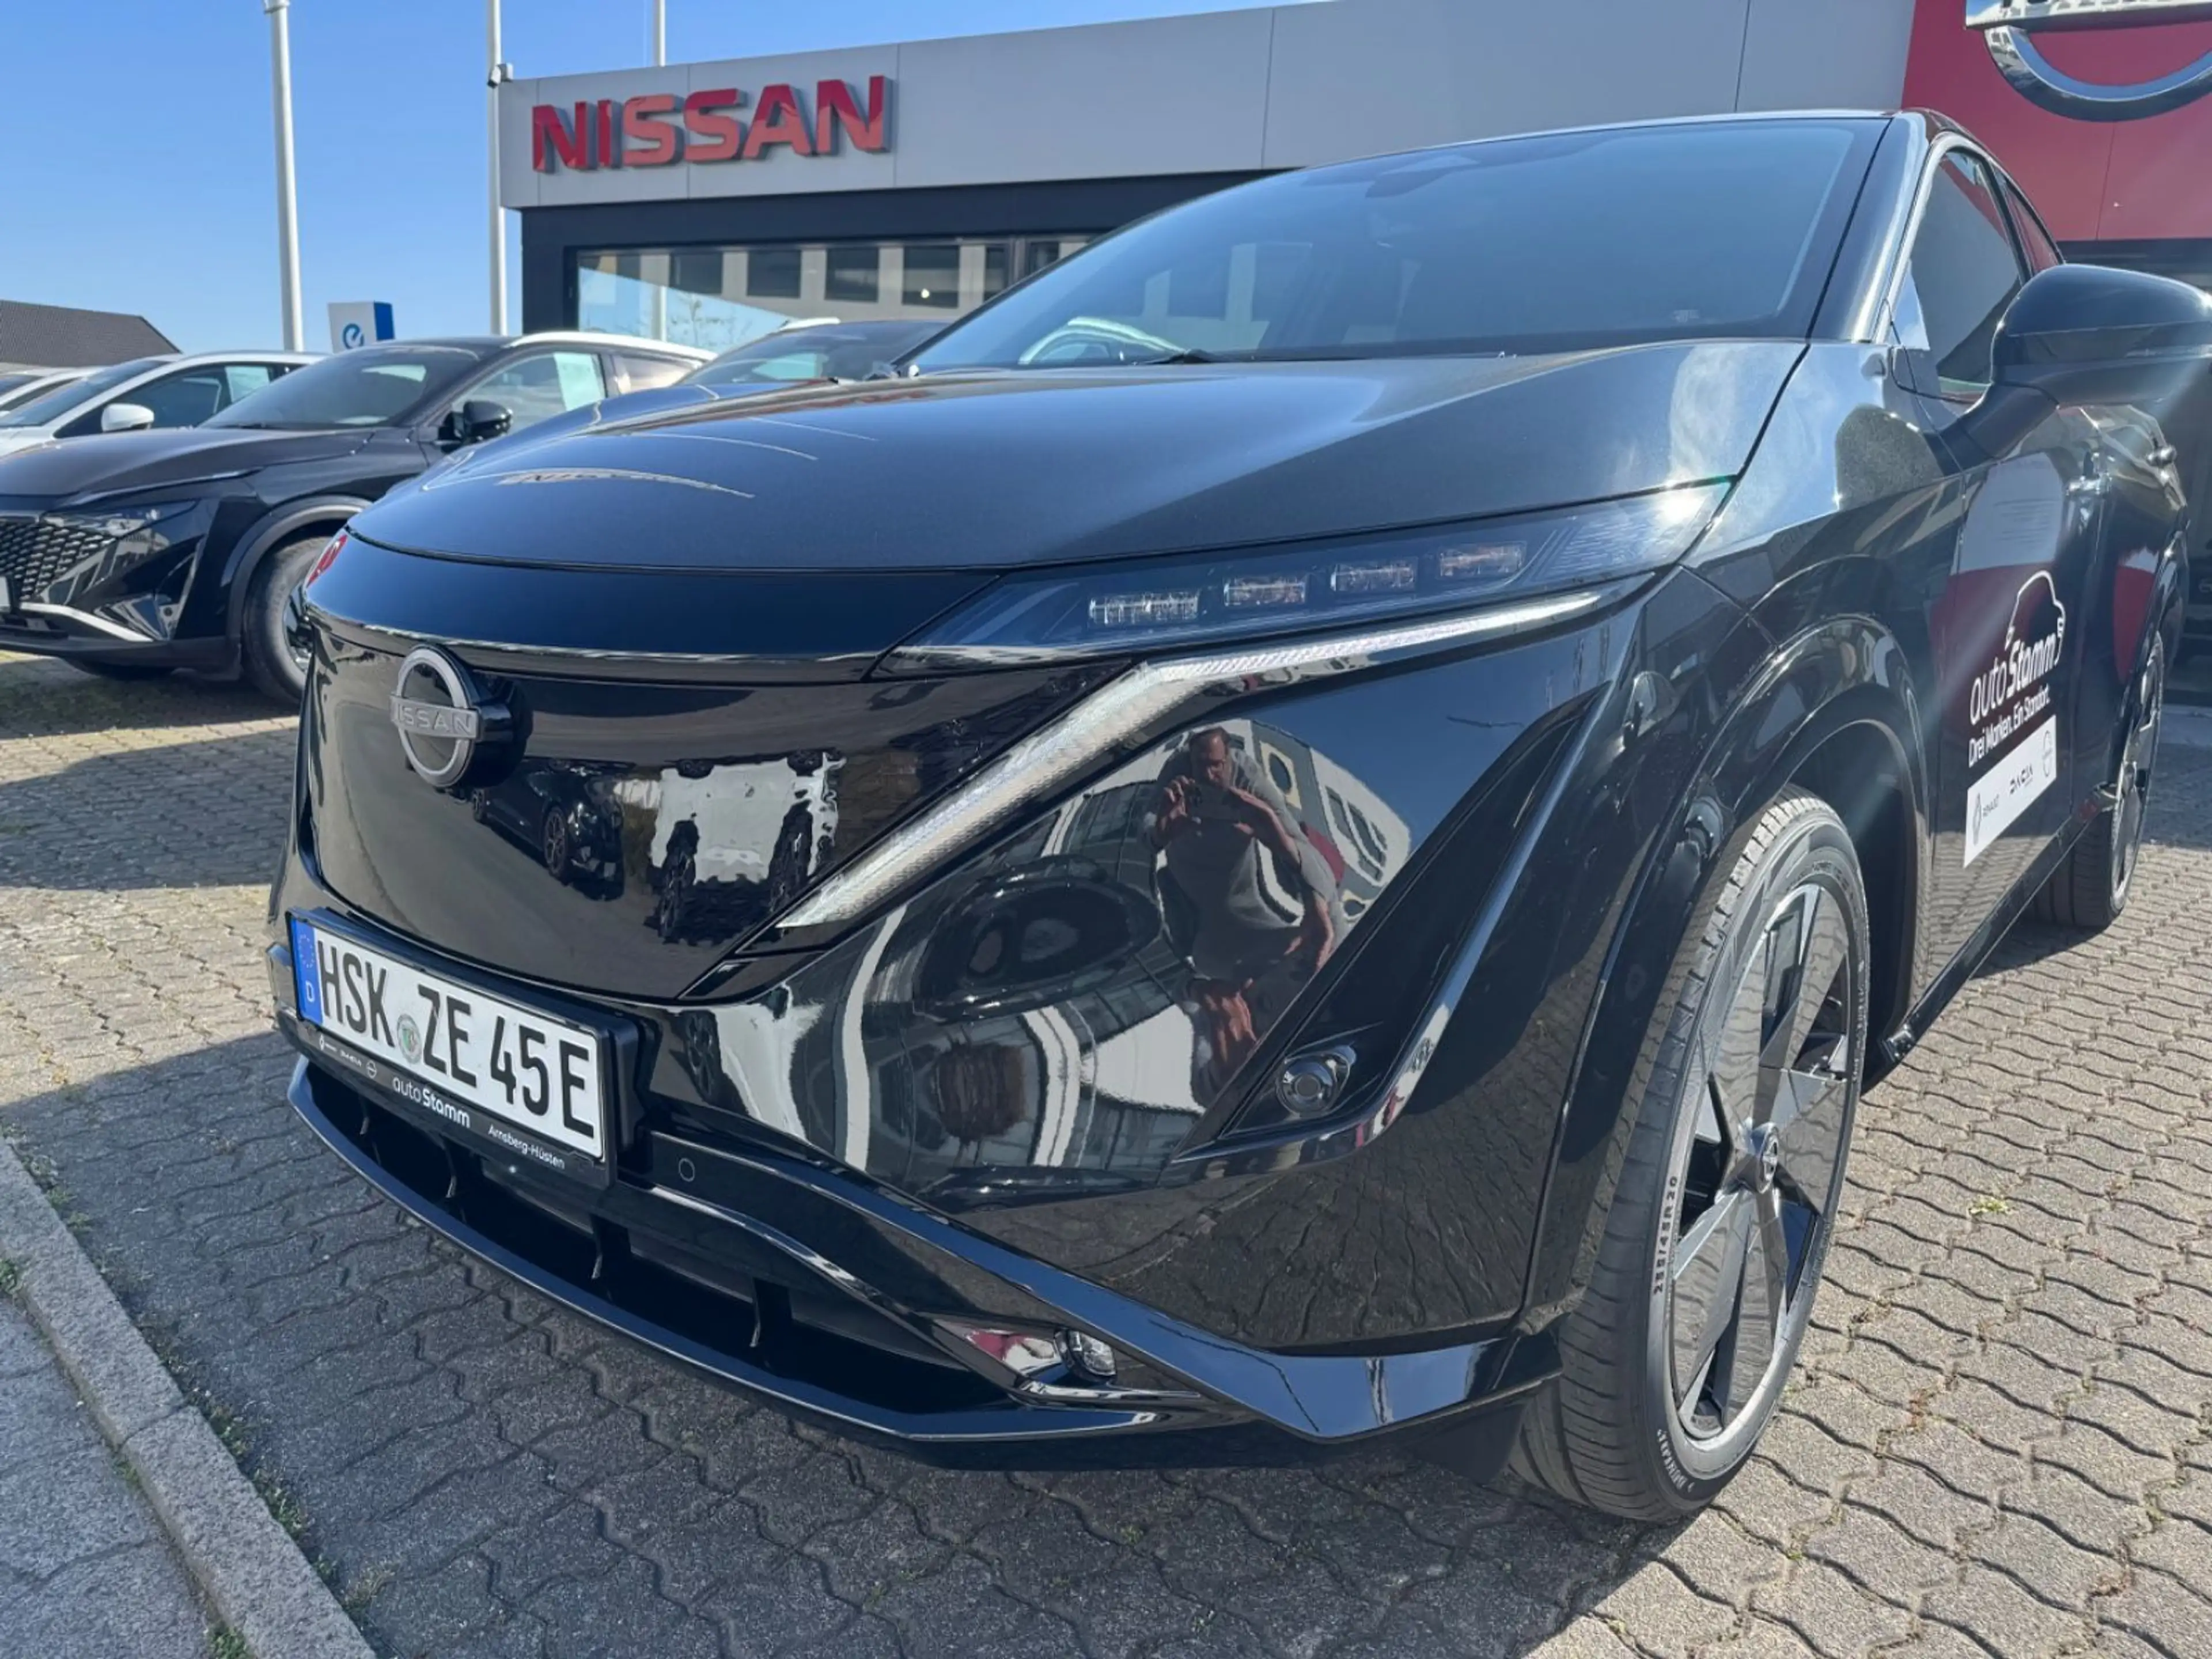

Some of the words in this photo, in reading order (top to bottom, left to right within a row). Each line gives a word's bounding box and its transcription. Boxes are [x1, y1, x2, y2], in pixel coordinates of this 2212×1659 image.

[532, 75, 887, 172] NISSAN
[305, 980, 315, 1002] D
[317, 940, 395, 1048] HSK
[418, 984, 478, 1088] ZE
[490, 1015, 594, 1139] 45E
[488, 1124, 565, 1170] Arnsberg-Hüsten
